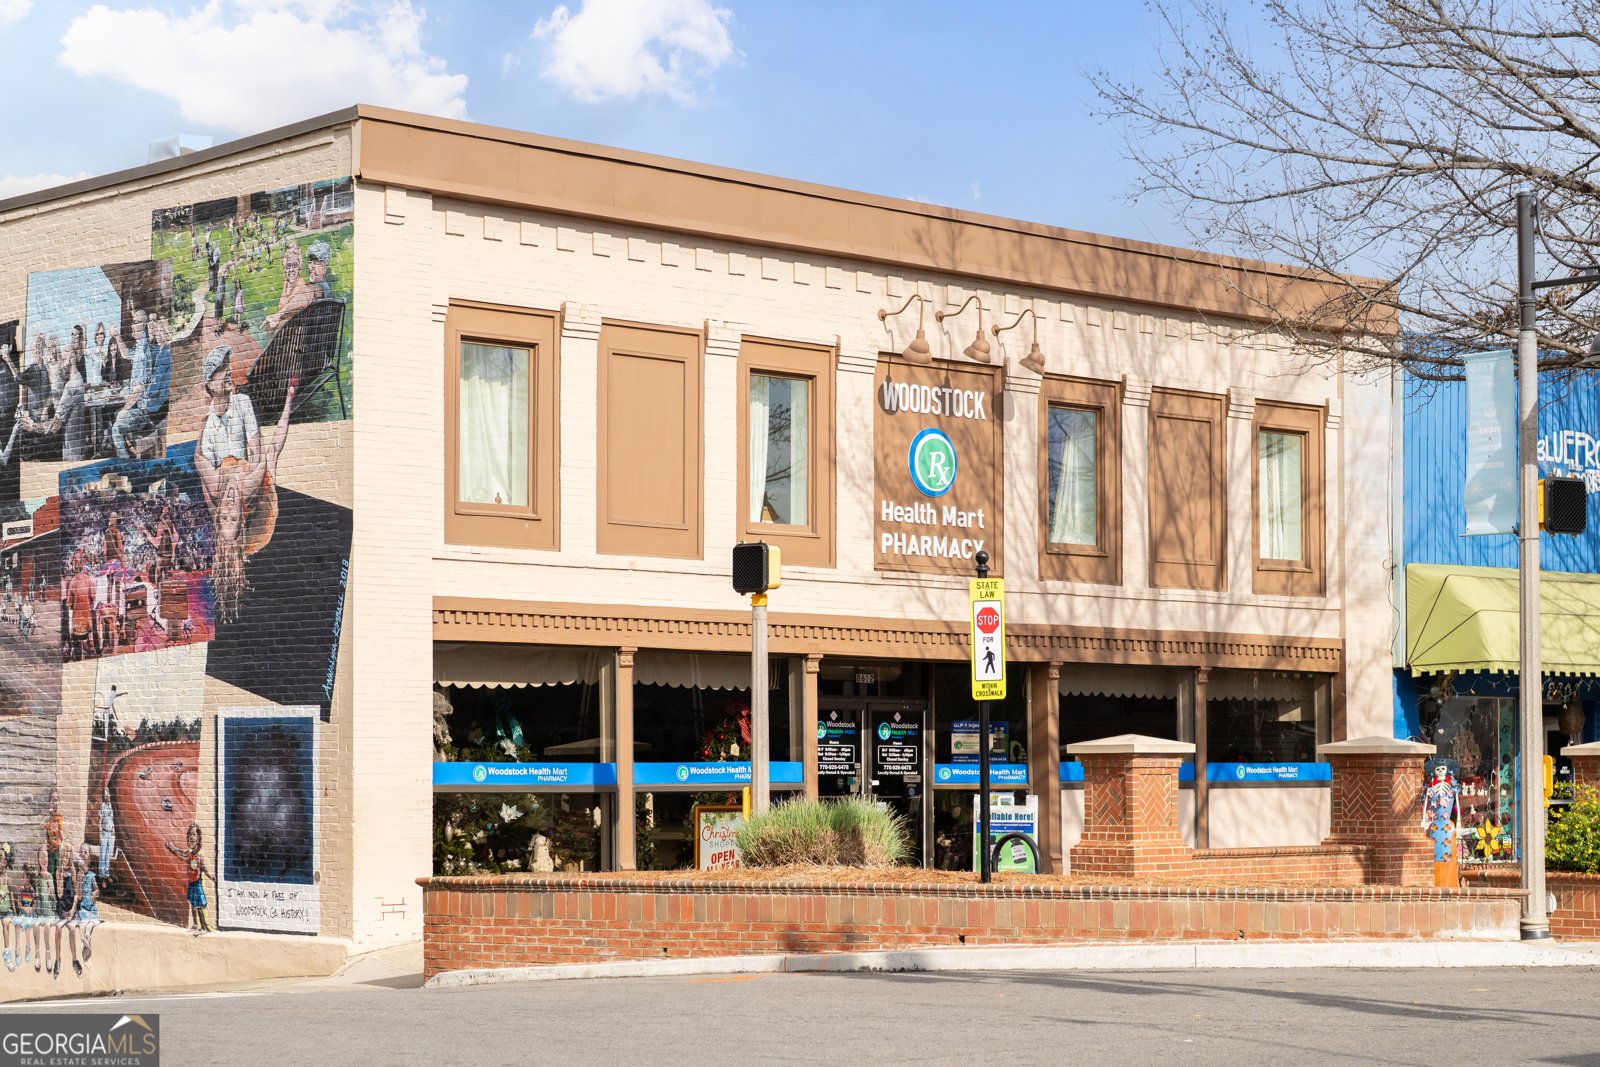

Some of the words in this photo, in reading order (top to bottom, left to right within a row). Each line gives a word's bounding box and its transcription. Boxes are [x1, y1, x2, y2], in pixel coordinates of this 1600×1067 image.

[883, 380, 986, 420] WOODSTOCK
[881, 501, 936, 525] Health
[942, 505, 985, 529] Mart
[881, 532, 985, 560] PHARMACY
[340, 558, 349, 588] 2018
[976, 581, 998, 590] STATE
[978, 615, 999, 625] STOP
[976, 689, 1003, 697] CROSSWALK
[488, 767, 528, 775] Woodstock
[529, 767, 551, 775] Health
[690, 766, 726, 775] Woodstock
[727, 766, 746, 774] Health
[1015, 813, 1033, 821] Here!
[702, 825, 737, 841] Christm
[711, 849, 735, 865] OPEN
[227, 888, 233, 897] I
[237, 890, 245, 898] AM
[272, 891, 284, 900] PART
[289, 892, 299, 900] OF
